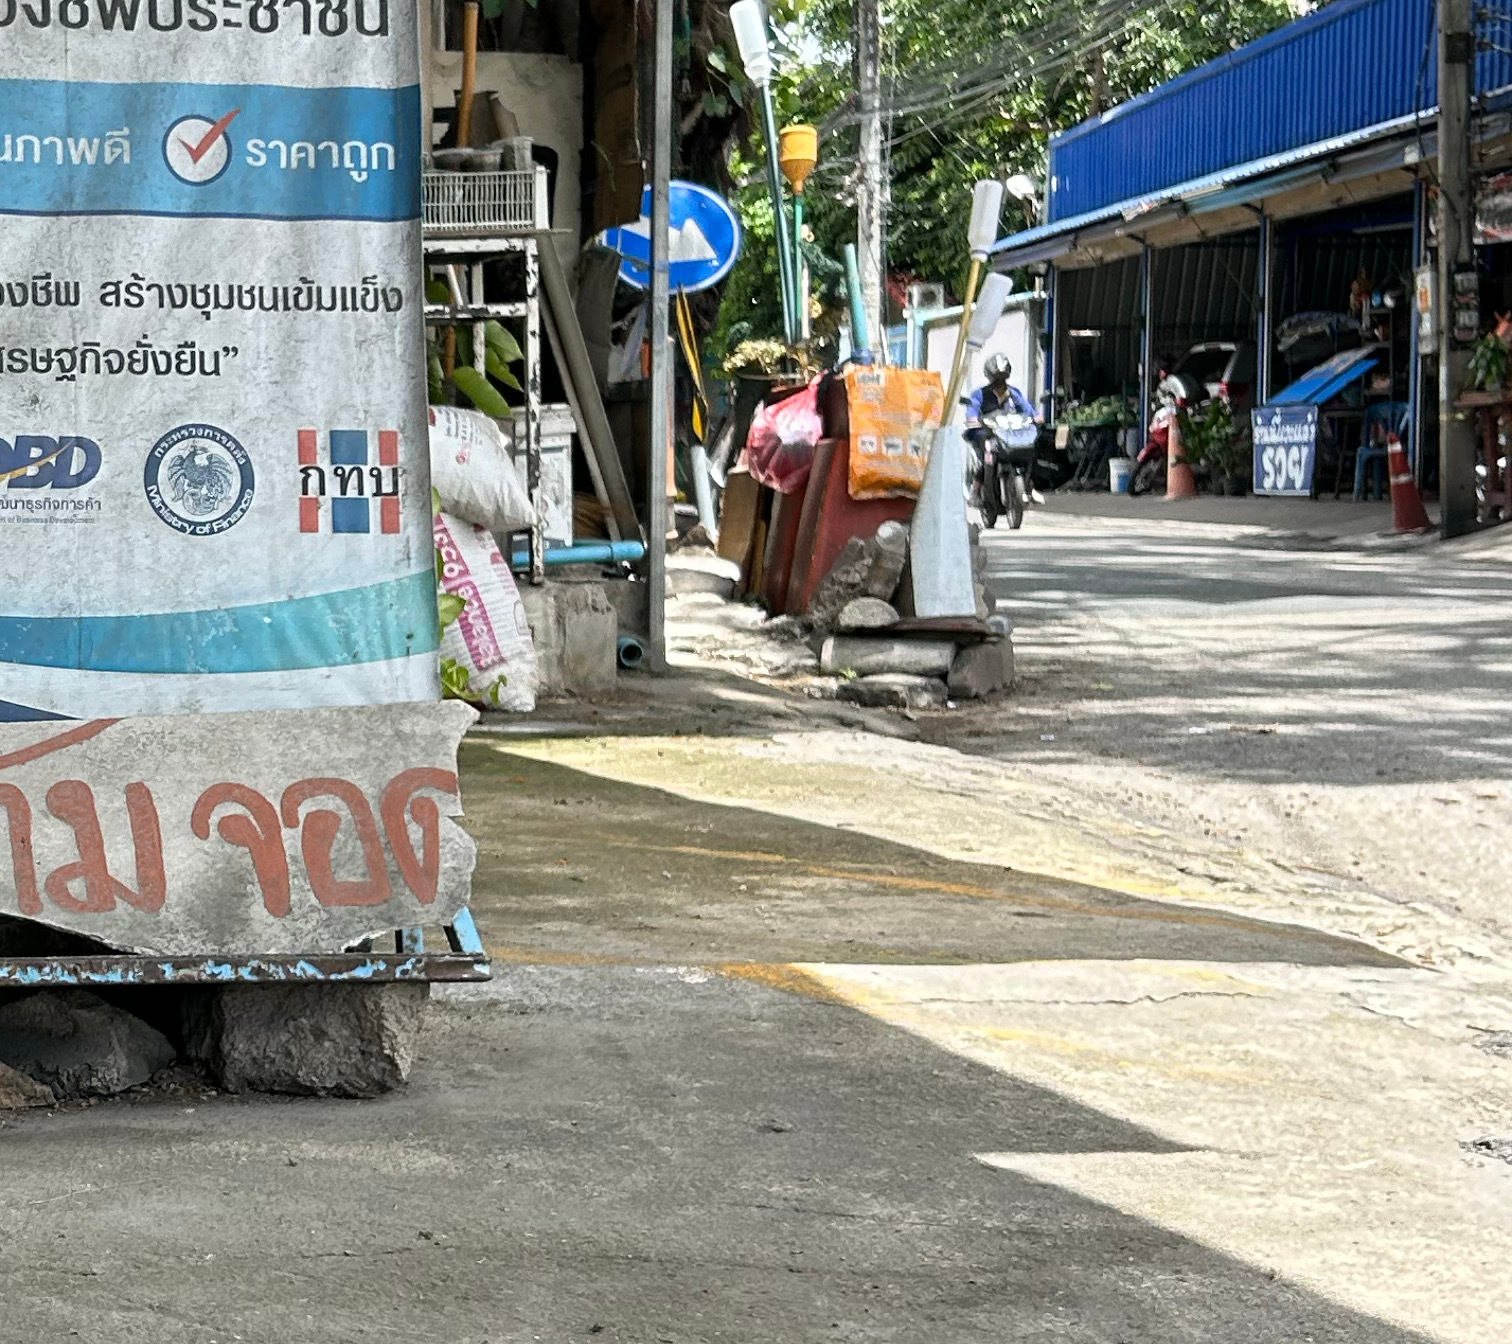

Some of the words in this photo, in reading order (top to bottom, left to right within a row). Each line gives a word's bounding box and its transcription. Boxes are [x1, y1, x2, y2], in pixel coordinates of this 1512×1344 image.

[245, 137, 396, 183] ราคาถูก
[99, 272, 404, 320] สร้างชุมชนเข้มแข็ง
[299, 465, 400, 497] กทบ
[147, 484, 193, 534] Ministry
[195, 521, 213, 534] of
[213, 488, 254, 533] Finance
